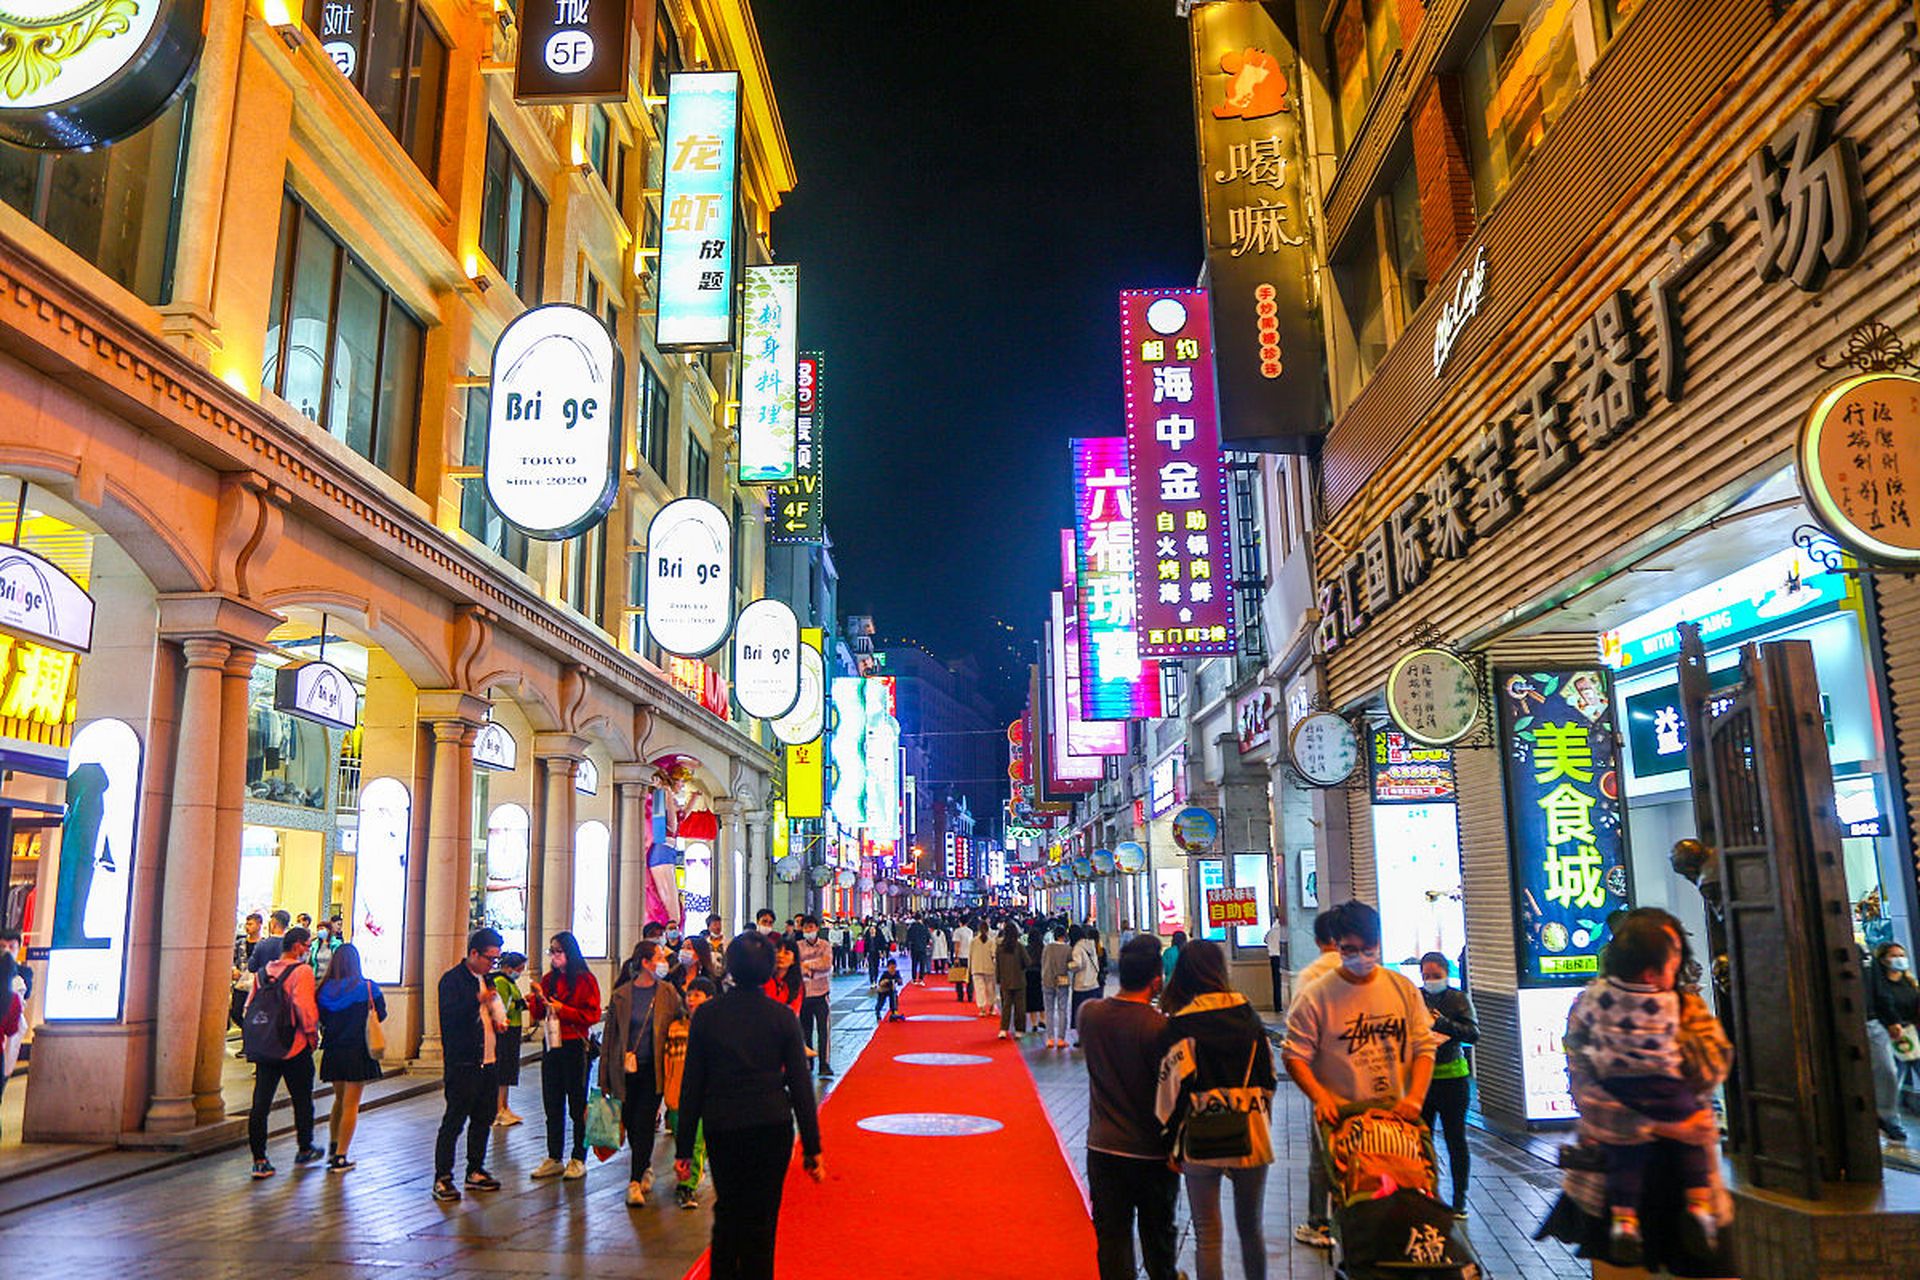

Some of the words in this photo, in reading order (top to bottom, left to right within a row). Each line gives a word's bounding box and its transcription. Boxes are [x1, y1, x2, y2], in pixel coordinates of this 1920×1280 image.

[551, 42, 587, 66] 5F
[665, 133, 724, 233] 龙虾
[1215, 135, 1303, 257] 喝嘛
[697, 239, 726, 291] 放题
[506, 390, 598, 429] Brige
[1152, 365, 1201, 502] 海中金
[783, 501, 810, 517] 4F
[1156, 510, 1208, 533] 自助
[658, 557, 721, 585] Brige
[743, 644, 791, 665] Brige
[1641, 631, 1675, 656] WITH
[1531, 720, 1606, 909] 美食城
[1211, 901, 1257, 921] 自助餐
